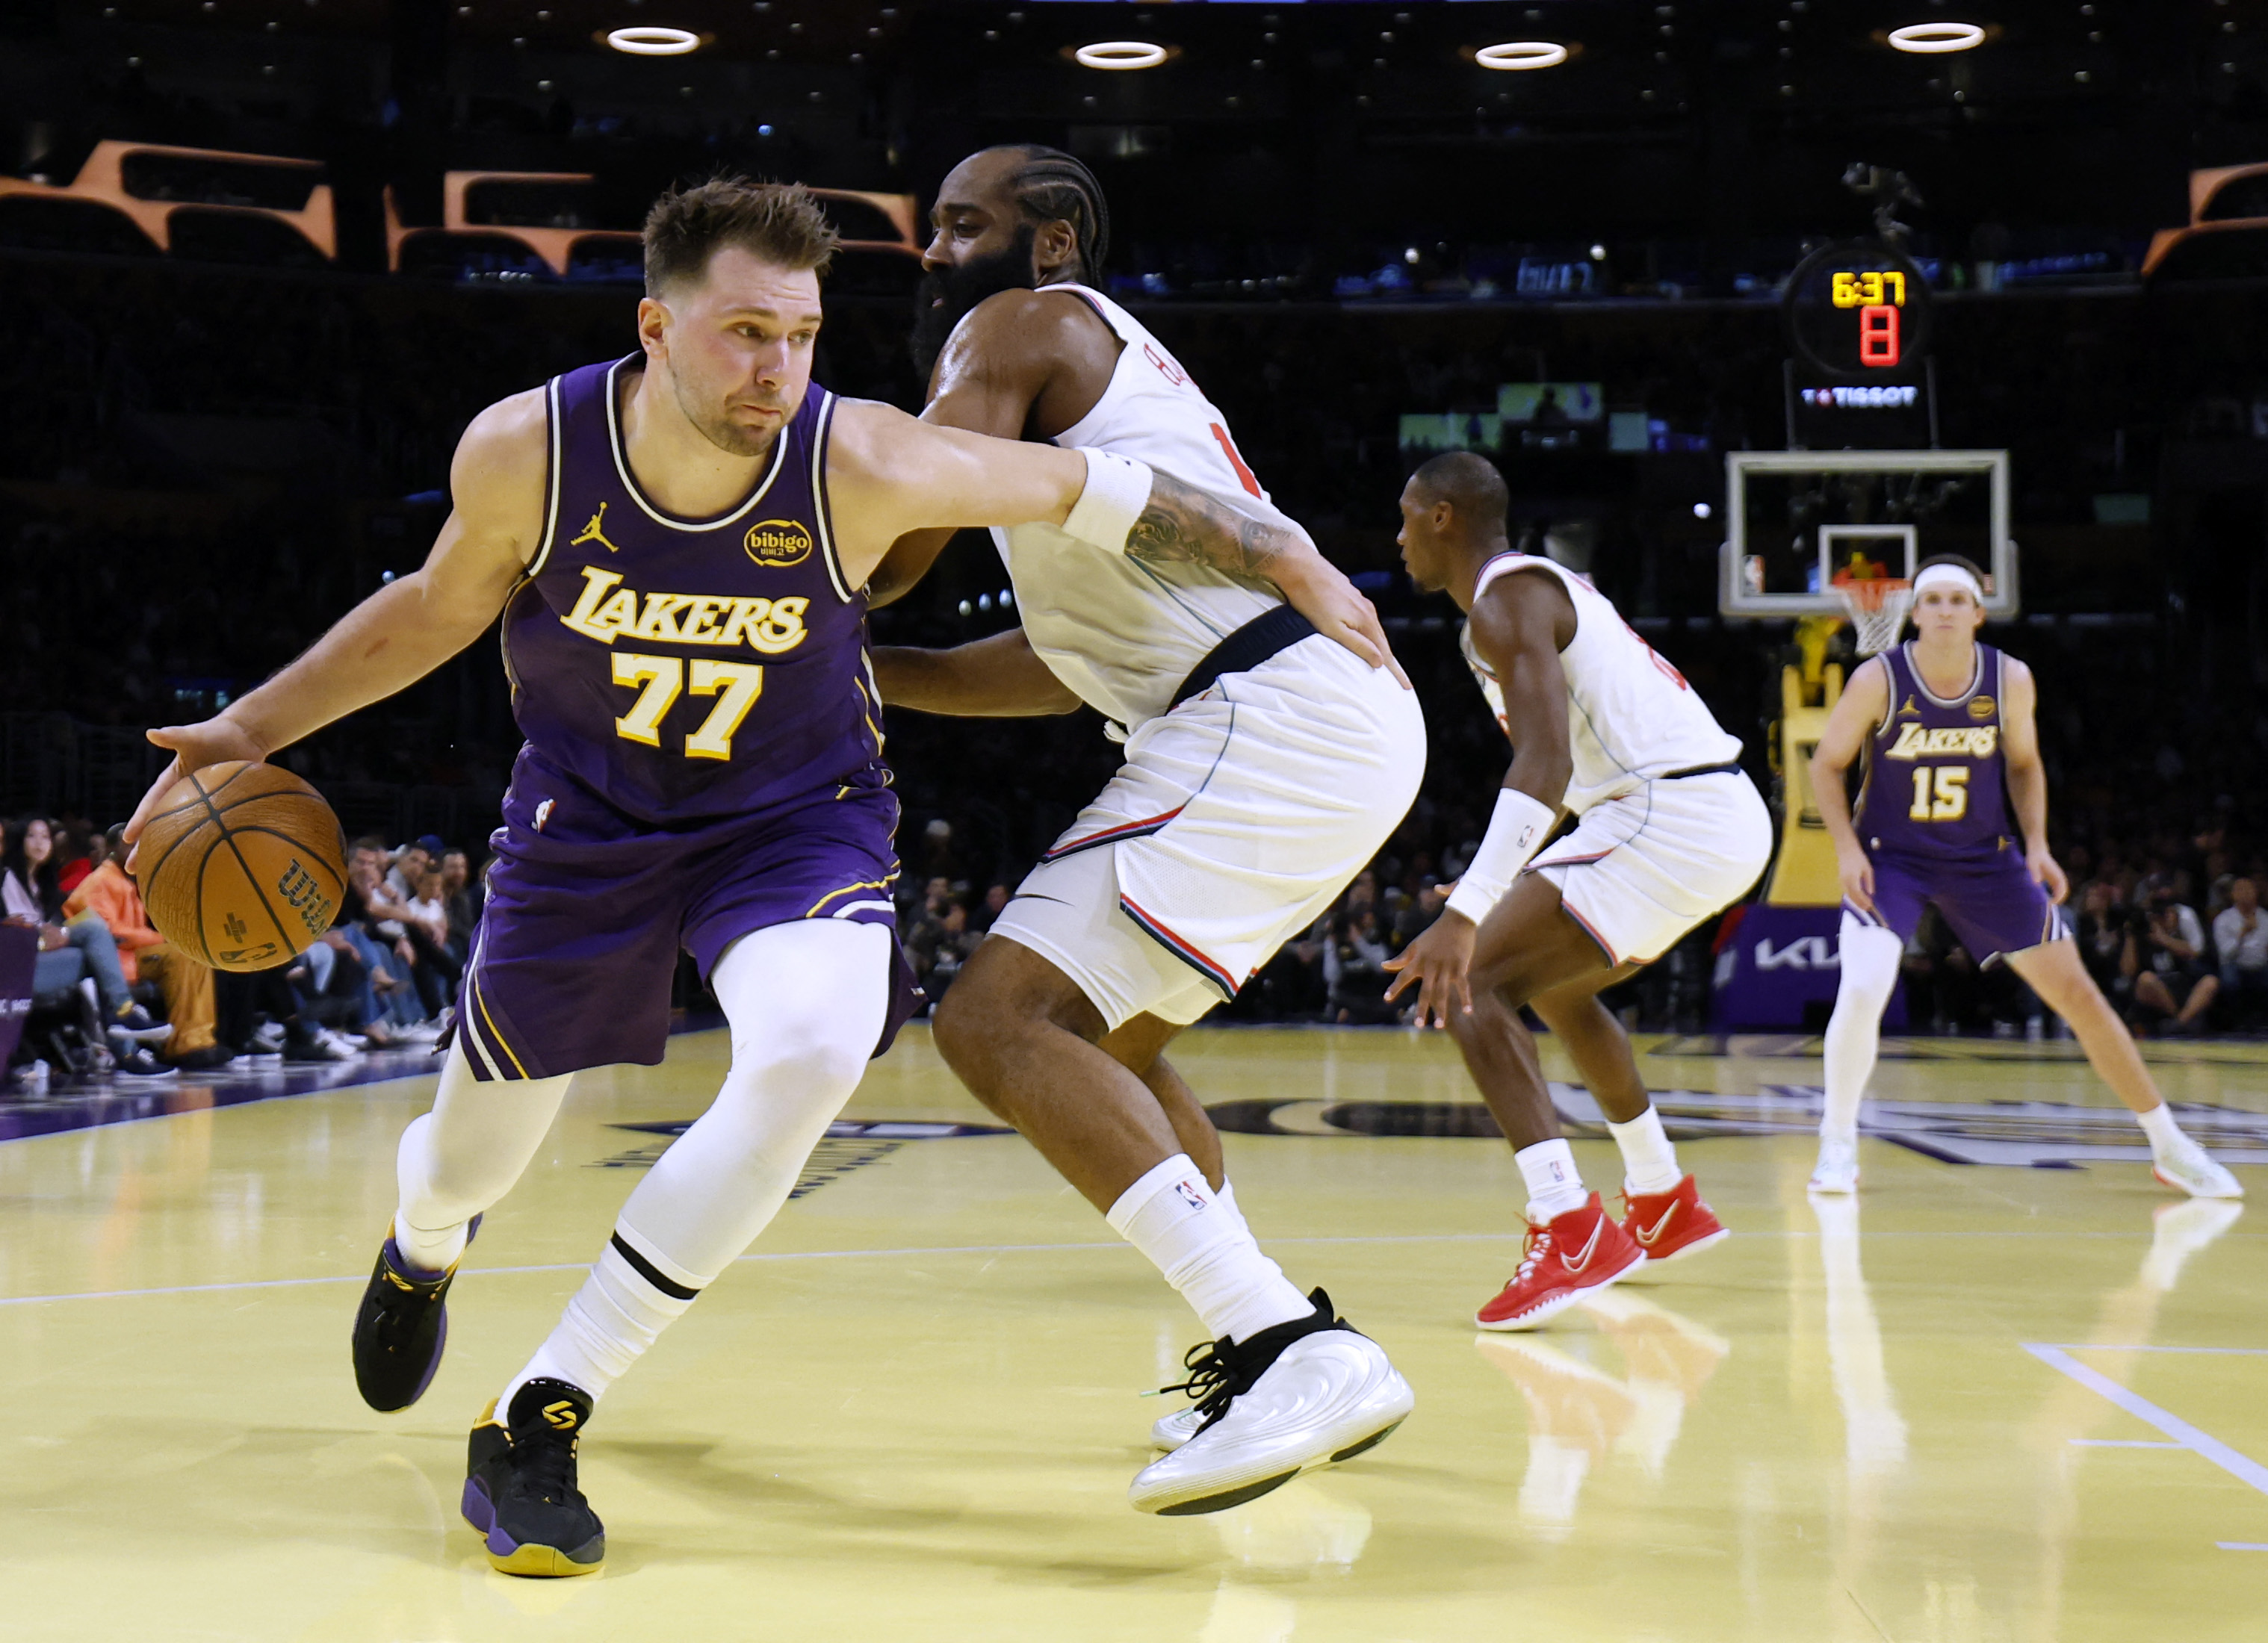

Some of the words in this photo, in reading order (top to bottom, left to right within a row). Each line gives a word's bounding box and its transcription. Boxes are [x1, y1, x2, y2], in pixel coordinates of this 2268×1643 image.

[1832, 271, 1906, 308] 6:37
[1859, 305, 1900, 367] 8
[750, 531, 808, 553] bibigo
[560, 565, 811, 654] LAKERS
[610, 651, 763, 762] 77
[1885, 721, 1999, 762] LAKERS
[1909, 765, 1970, 822] 15
[1755, 936, 1841, 971] KI
